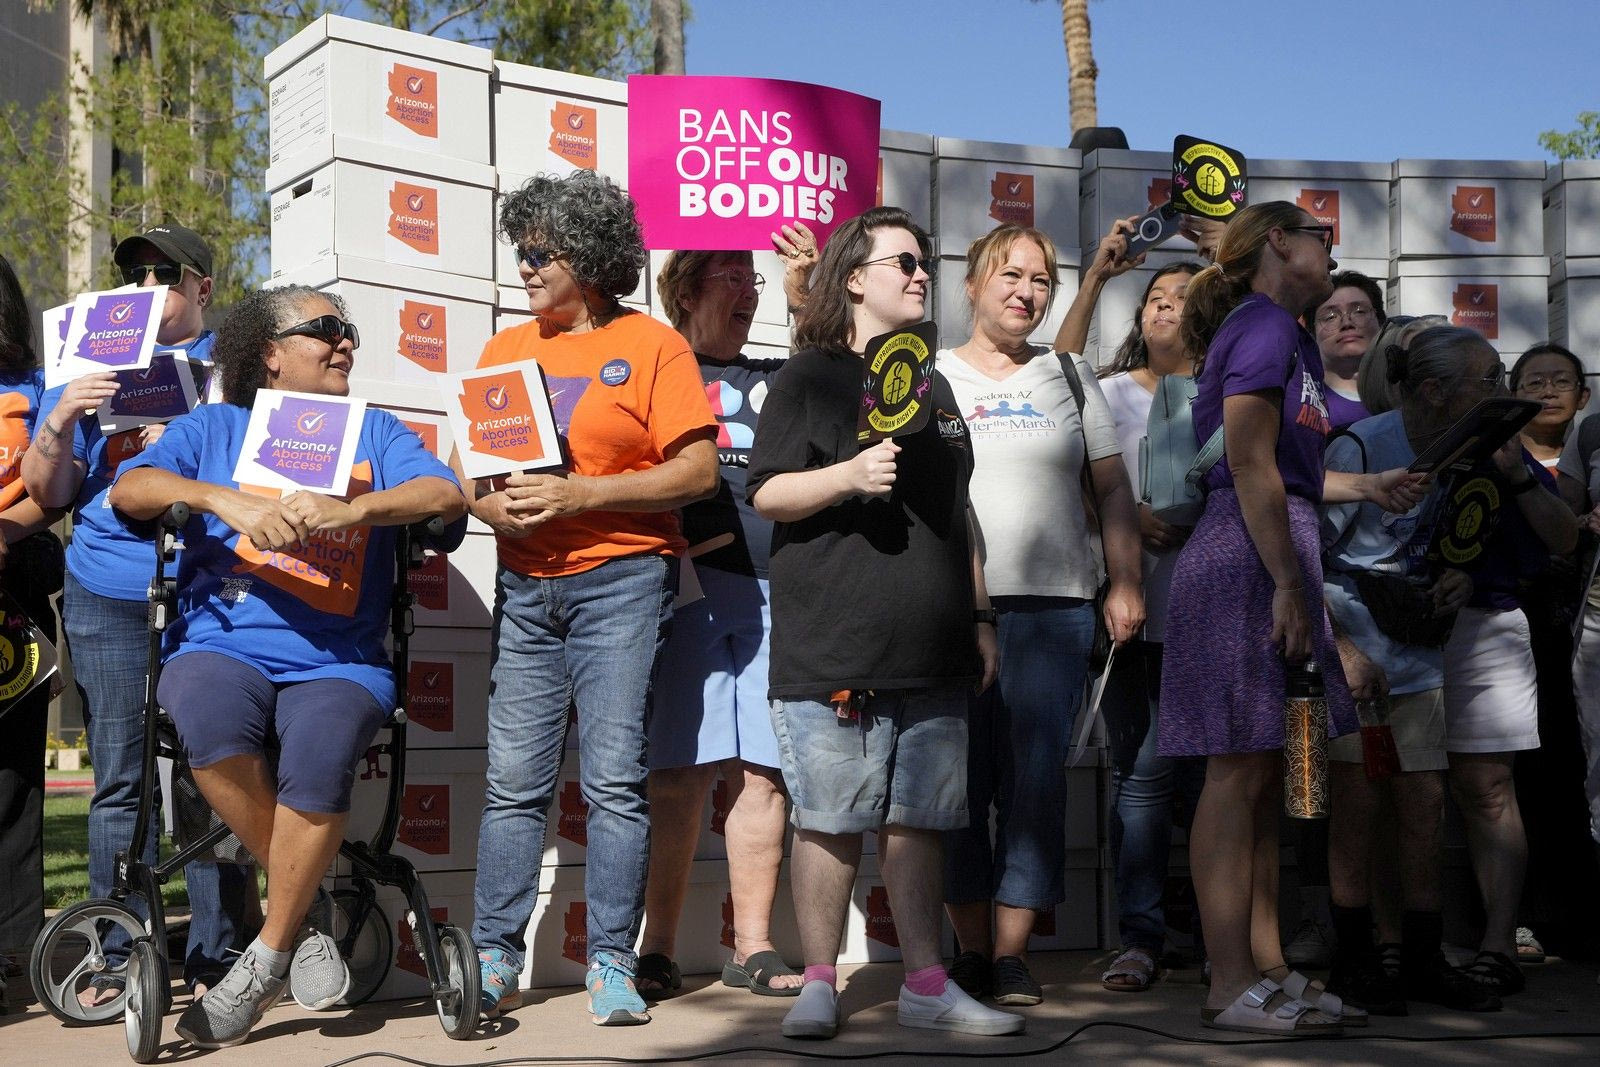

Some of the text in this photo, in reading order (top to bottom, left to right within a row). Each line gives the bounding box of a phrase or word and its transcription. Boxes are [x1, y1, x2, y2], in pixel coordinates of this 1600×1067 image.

[272, 83, 287, 99] STORAGE
[394, 96, 429, 109] Arizona
[397, 104, 433, 117] Abortion
[401, 113, 429, 124] Access
[679, 108, 793, 146] BANS
[556, 132, 588, 144] Arizona
[558, 141, 592, 152] Abortion
[562, 148, 589, 159] Access
[1186, 146, 1236, 173] REPRODUCTIVE RIGHTS
[676, 145, 848, 192] OFF OUR
[273, 201, 291, 214] STORAGE
[679, 182, 836, 224] BODIES
[996, 200, 1026, 208] Arizona
[1214, 203, 1232, 213] RIGHTS
[395, 214, 429, 227] Arizona
[1457, 212, 1488, 220] Arizona
[398, 223, 434, 235] Abortion
[402, 231, 430, 242] Access
[89, 328, 134, 341] Arizona
[405, 333, 438, 345] Arizona
[89, 337, 138, 349] Abortion
[408, 342, 443, 353] Abortion
[91, 345, 130, 356] Access
[411, 350, 439, 360] Access
[874, 336, 926, 369] REPRODUCTIVE RIGHTS
[120, 385, 169, 400] Arizona
[1018, 390, 1033, 399] AZ
[476, 415, 523, 431] Arizona
[880, 421, 896, 429] HUMAN
[896, 404, 916, 424] RIGHTS
[968, 420, 992, 431] fter
[1010, 417, 1057, 429] March
[482, 425, 532, 442] Abortion
[271, 438, 326, 452] Arizona
[490, 436, 529, 451] Access
[271, 448, 332, 462] Abortion
[276, 458, 323, 471] Access
[291, 540, 355, 569] ortion
[411, 695, 444, 703] Arizona
[405, 817, 440, 827] Arizona
